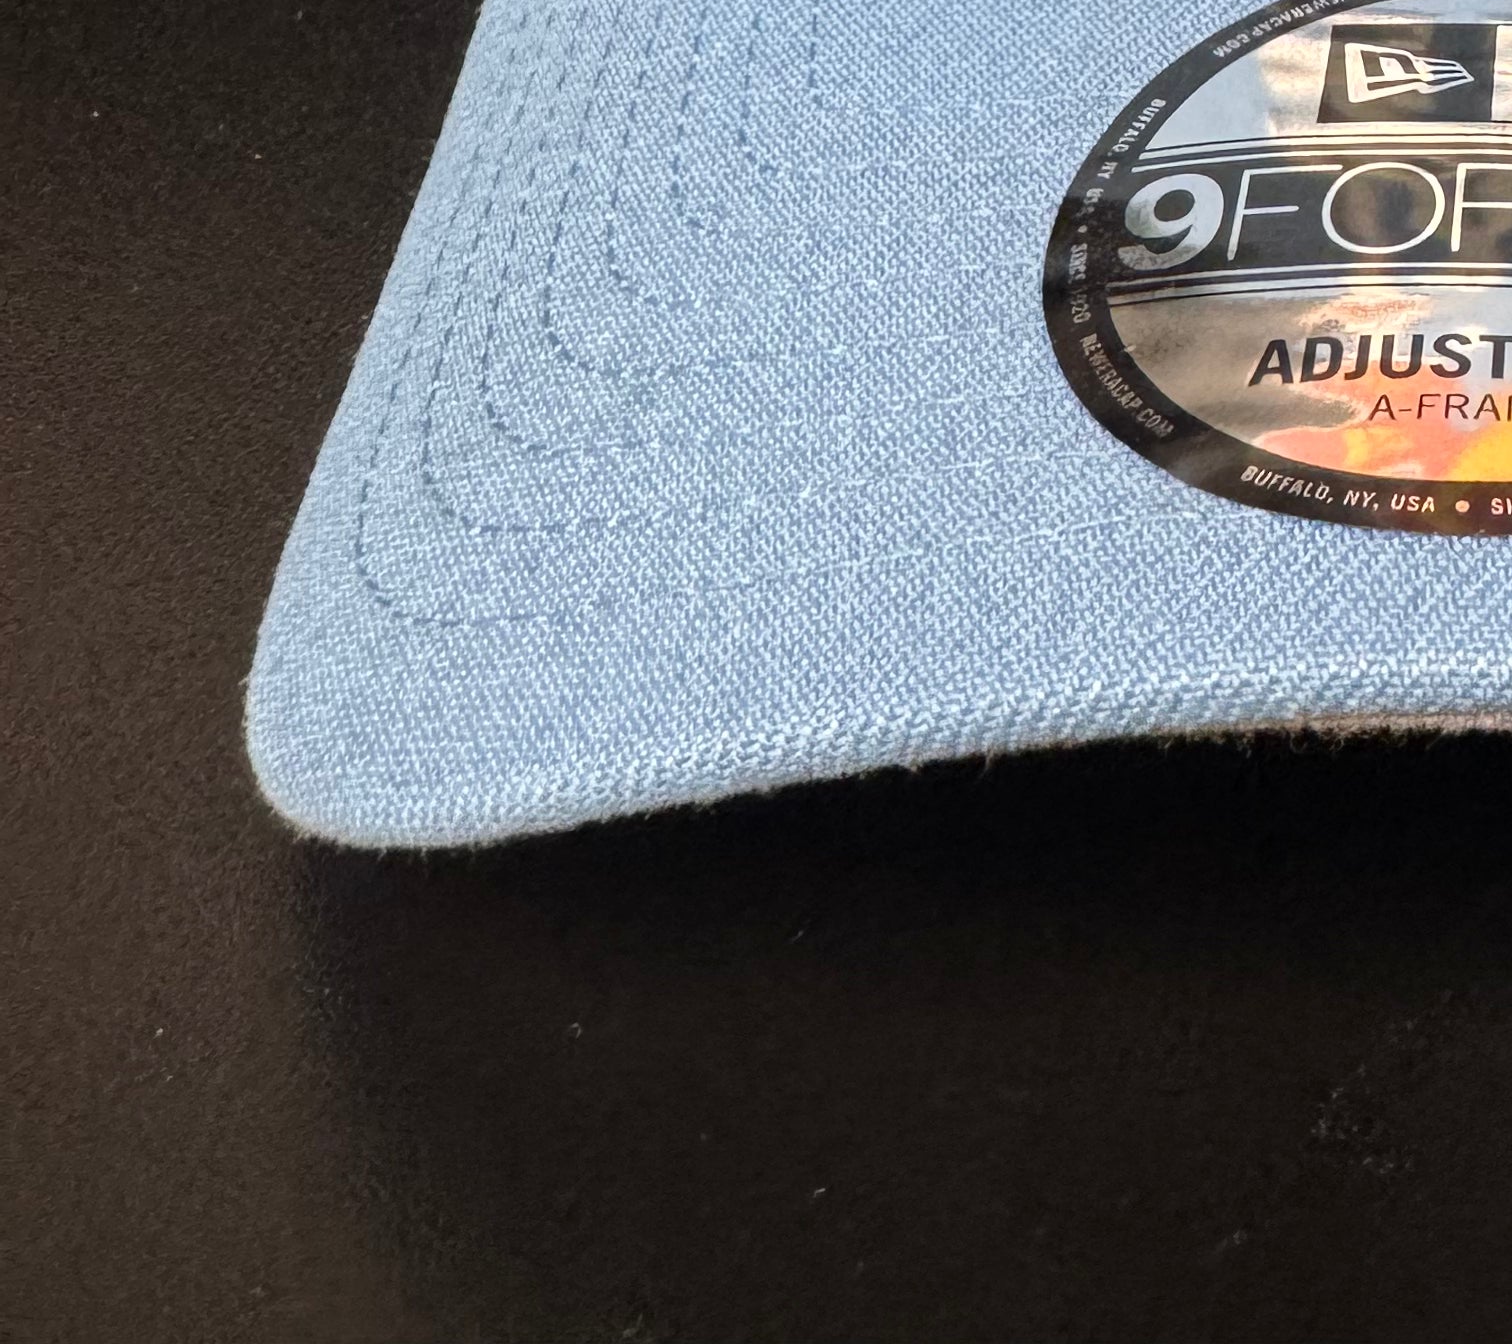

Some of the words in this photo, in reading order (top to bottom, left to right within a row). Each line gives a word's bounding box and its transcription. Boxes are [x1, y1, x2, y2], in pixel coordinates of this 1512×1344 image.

[1240, 465, 1334, 504] BUFFALO,
[1343, 489, 1379, 512] NY,
[1390, 493, 1436, 513] USA
